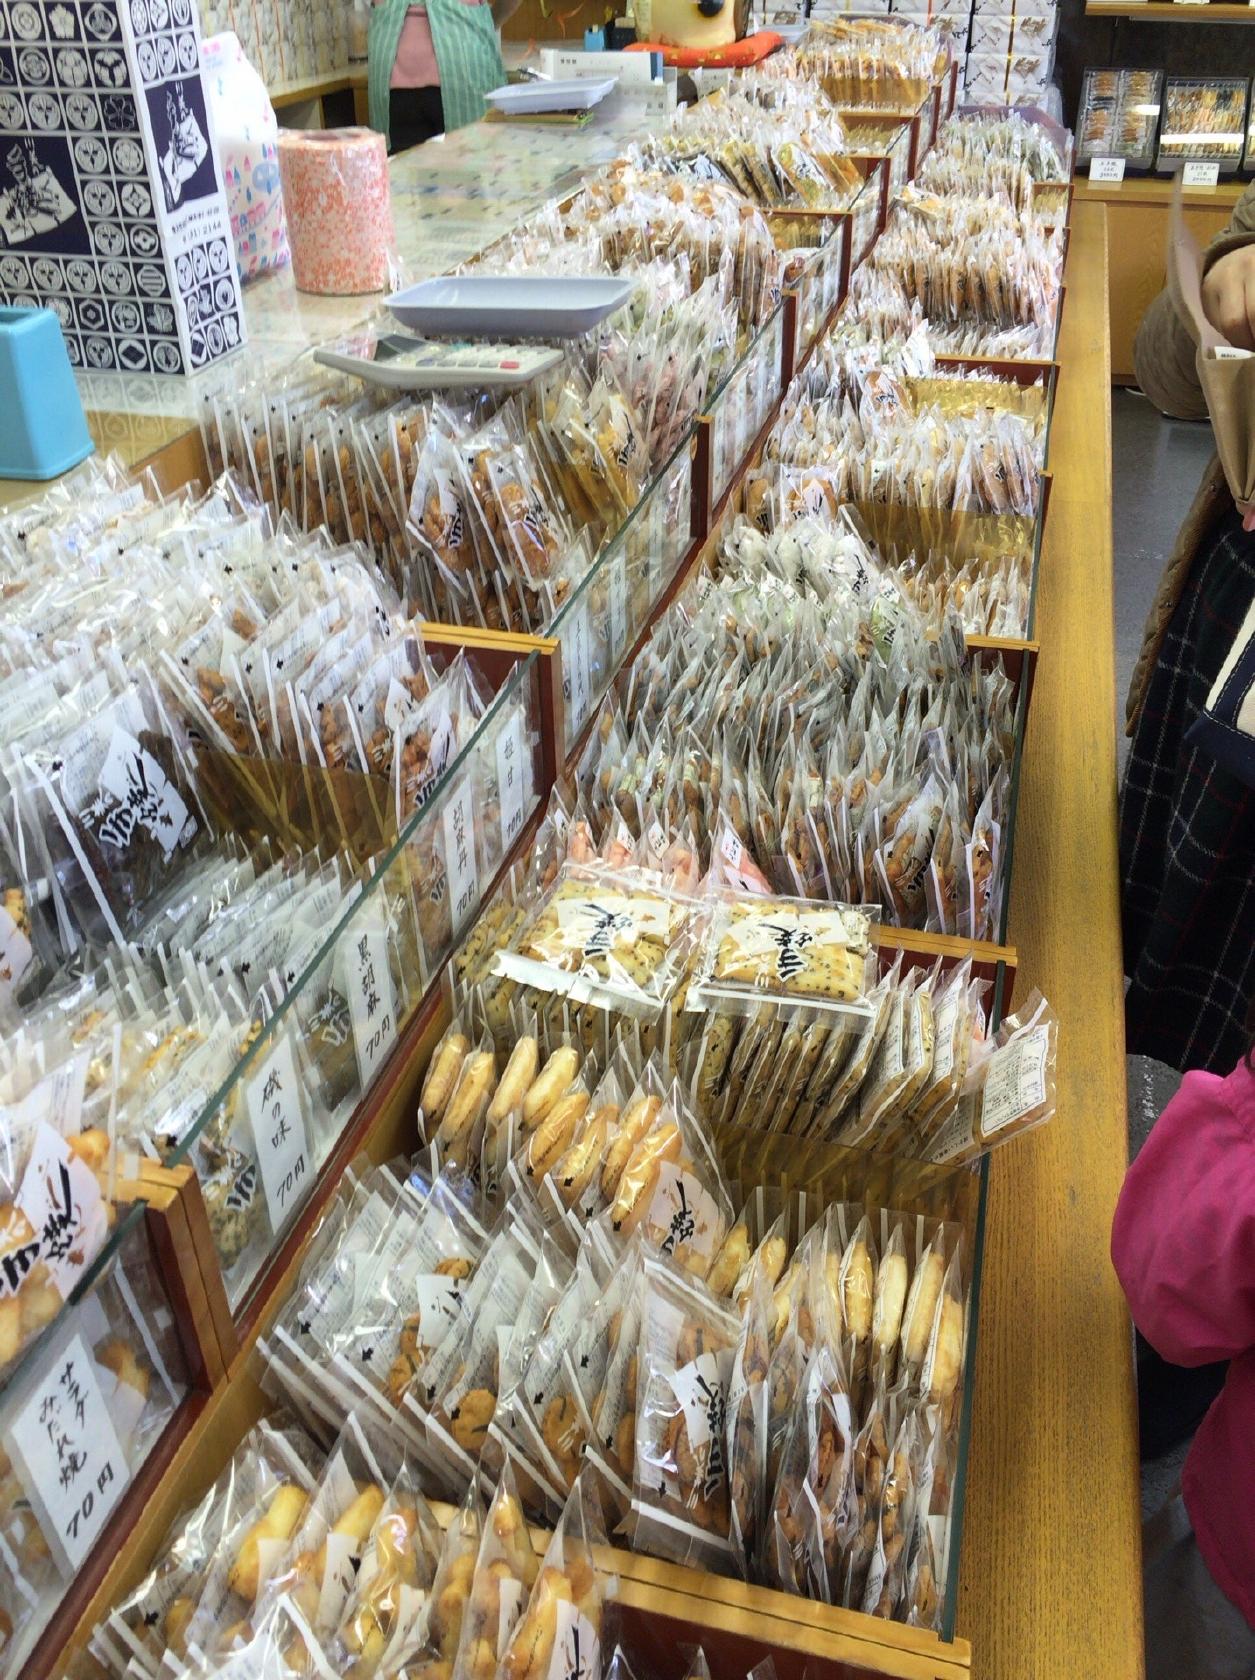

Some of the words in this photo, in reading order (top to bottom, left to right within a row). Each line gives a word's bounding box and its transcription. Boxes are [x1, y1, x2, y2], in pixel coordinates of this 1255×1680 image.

[357, 933, 381, 1021] 黒胡麻
[365, 1017, 391, 1060] 70円
[261, 1069, 292, 1149] 磯の味
[276, 1154, 305, 1207] 70円
[60, 1361, 89, 1429] サラダ
[39, 1395, 87, 1493] みだれ焼
[66, 1461, 114, 1538] 70円
